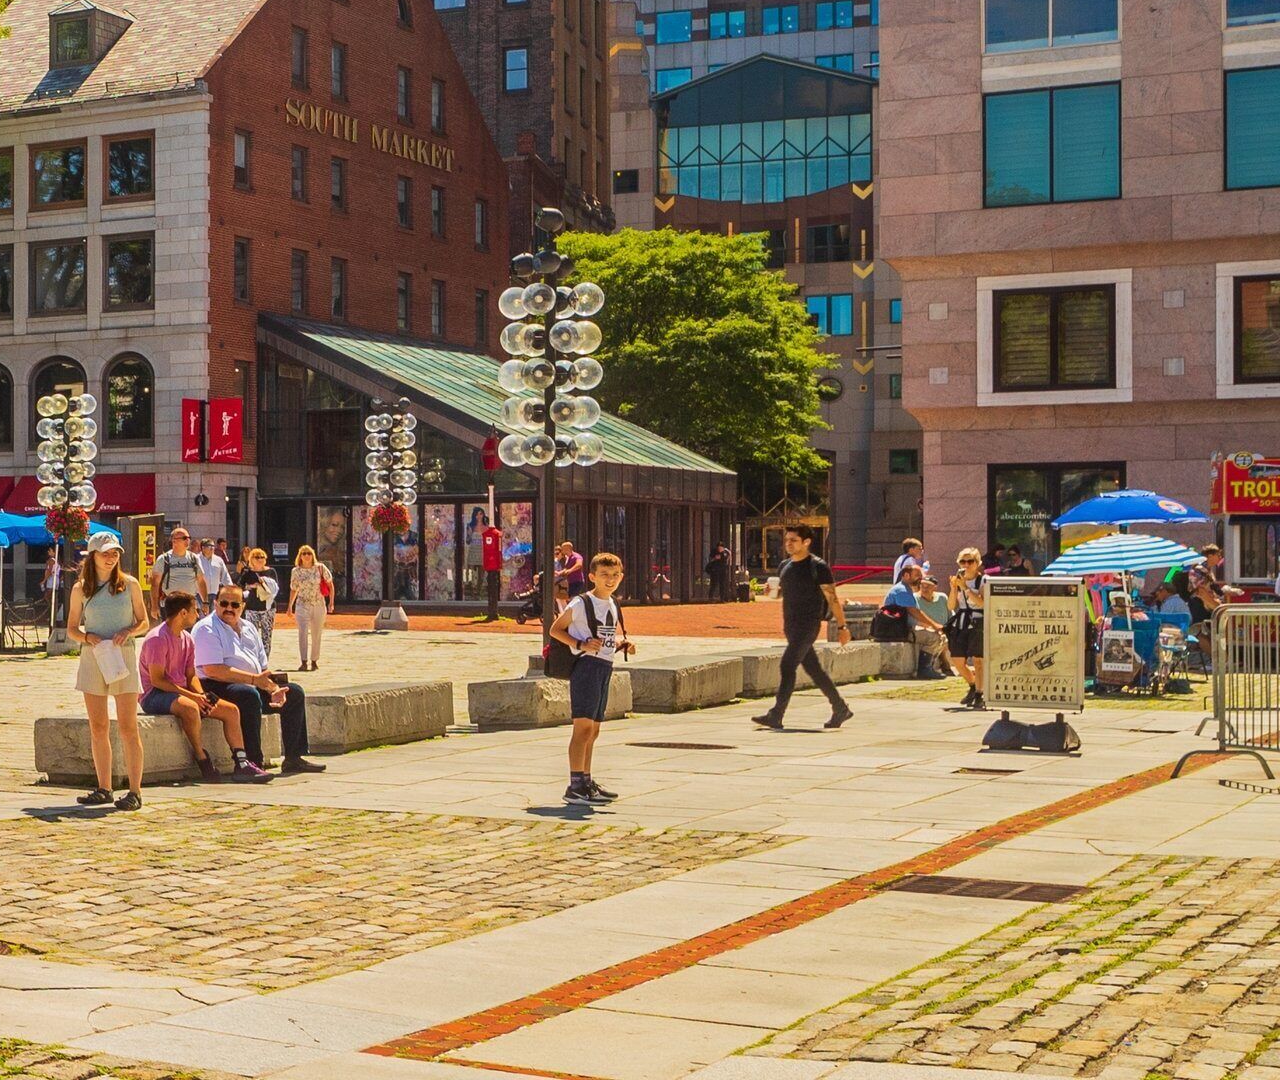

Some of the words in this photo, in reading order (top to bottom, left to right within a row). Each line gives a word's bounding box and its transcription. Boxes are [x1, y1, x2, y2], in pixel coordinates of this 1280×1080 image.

[285, 96, 359, 143] SOUTH
[370, 123, 455, 172] MARKET
[1000, 512, 1052, 520] abercrombie
[995, 609, 1037, 618] GREAT
[1038, 609, 1073, 619] HALL
[998, 623, 1038, 634] FANEUIL
[1044, 624, 1069, 635] HALL
[1000, 636, 1062, 672] UPSTAIRS
[995, 693, 1073, 702] SUFFRAGE!
